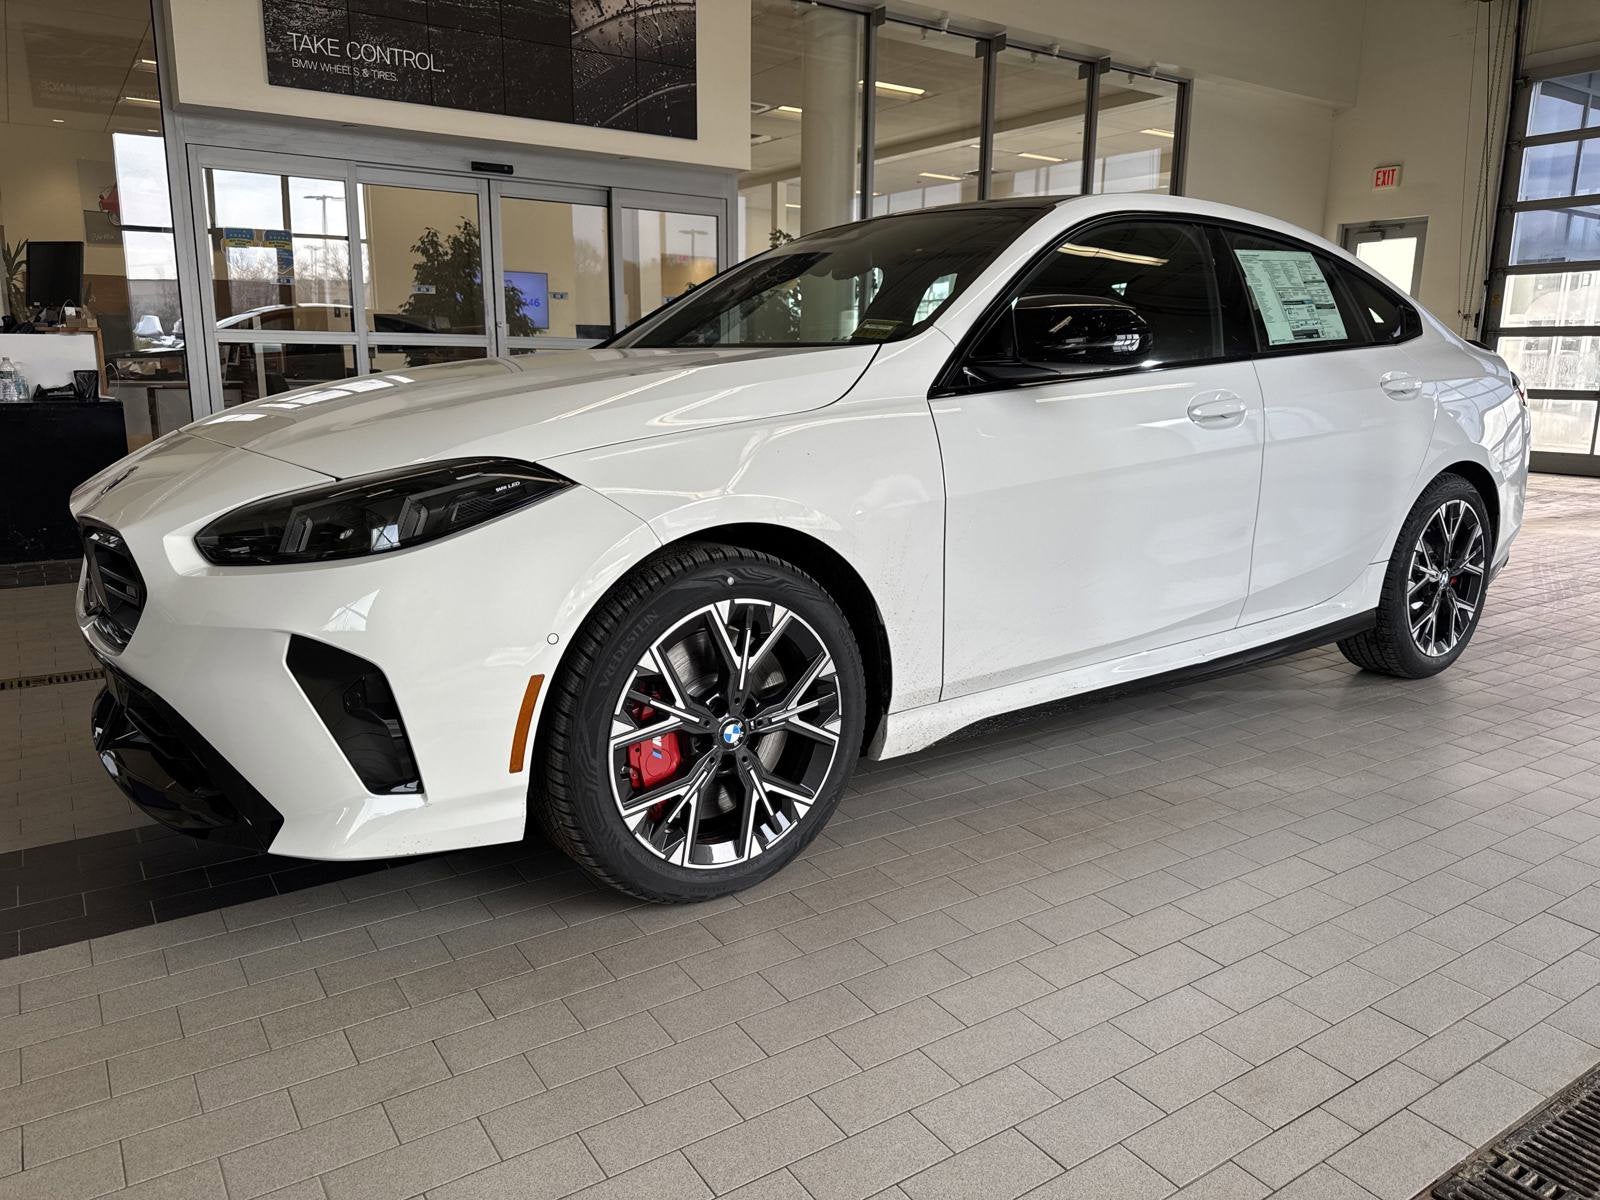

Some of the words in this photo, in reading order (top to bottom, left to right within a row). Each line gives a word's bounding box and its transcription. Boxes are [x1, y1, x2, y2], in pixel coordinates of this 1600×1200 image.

[286, 31, 341, 58] TAKE
[346, 41, 446, 73] CONTROL.
[291, 57, 318, 70] BMW
[320, 62, 360, 77] WHEELS
[361, 68, 369, 78] &
[1375, 167, 1397, 187] EXIT
[507, 480, 521, 489] LED
[599, 608, 660, 688] VREDESTEIN
